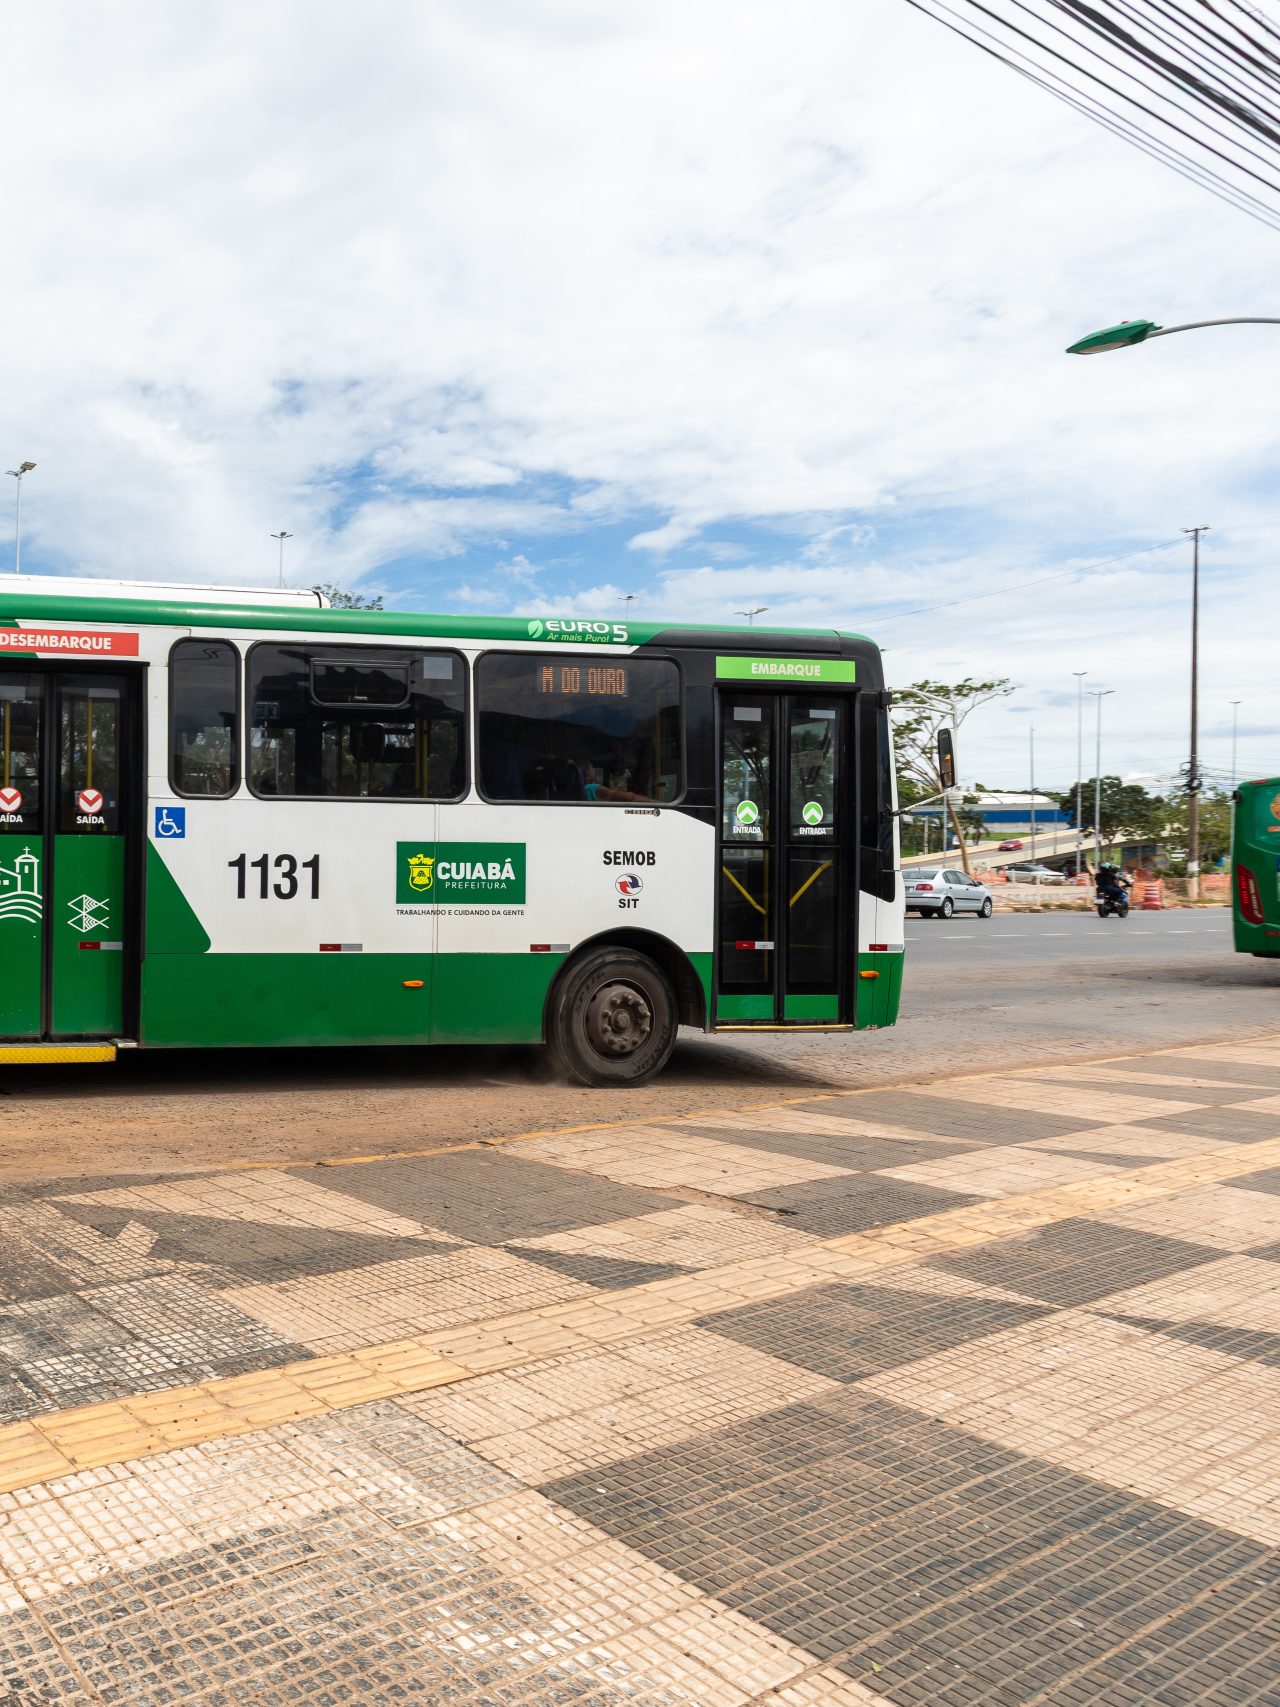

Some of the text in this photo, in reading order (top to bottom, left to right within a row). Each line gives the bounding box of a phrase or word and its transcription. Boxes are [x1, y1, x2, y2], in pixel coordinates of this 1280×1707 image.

[546, 621, 628, 642] EURO 5
[585, 634, 609, 642] Puro!
[751, 662, 821, 677] EMBARQUE
[542, 666, 625, 695] M DO OURO
[76, 814, 105, 824] SAÍDA
[733, 826, 761, 834] ENTRADA
[799, 827, 827, 835] ENTRADA
[602, 850, 656, 866] SEMOB
[437, 857, 516, 880] CUIABÁ
[228, 853, 320, 900] 1131
[445, 881, 507, 889] PREFEITURA
[618, 898, 640, 909] SIT
